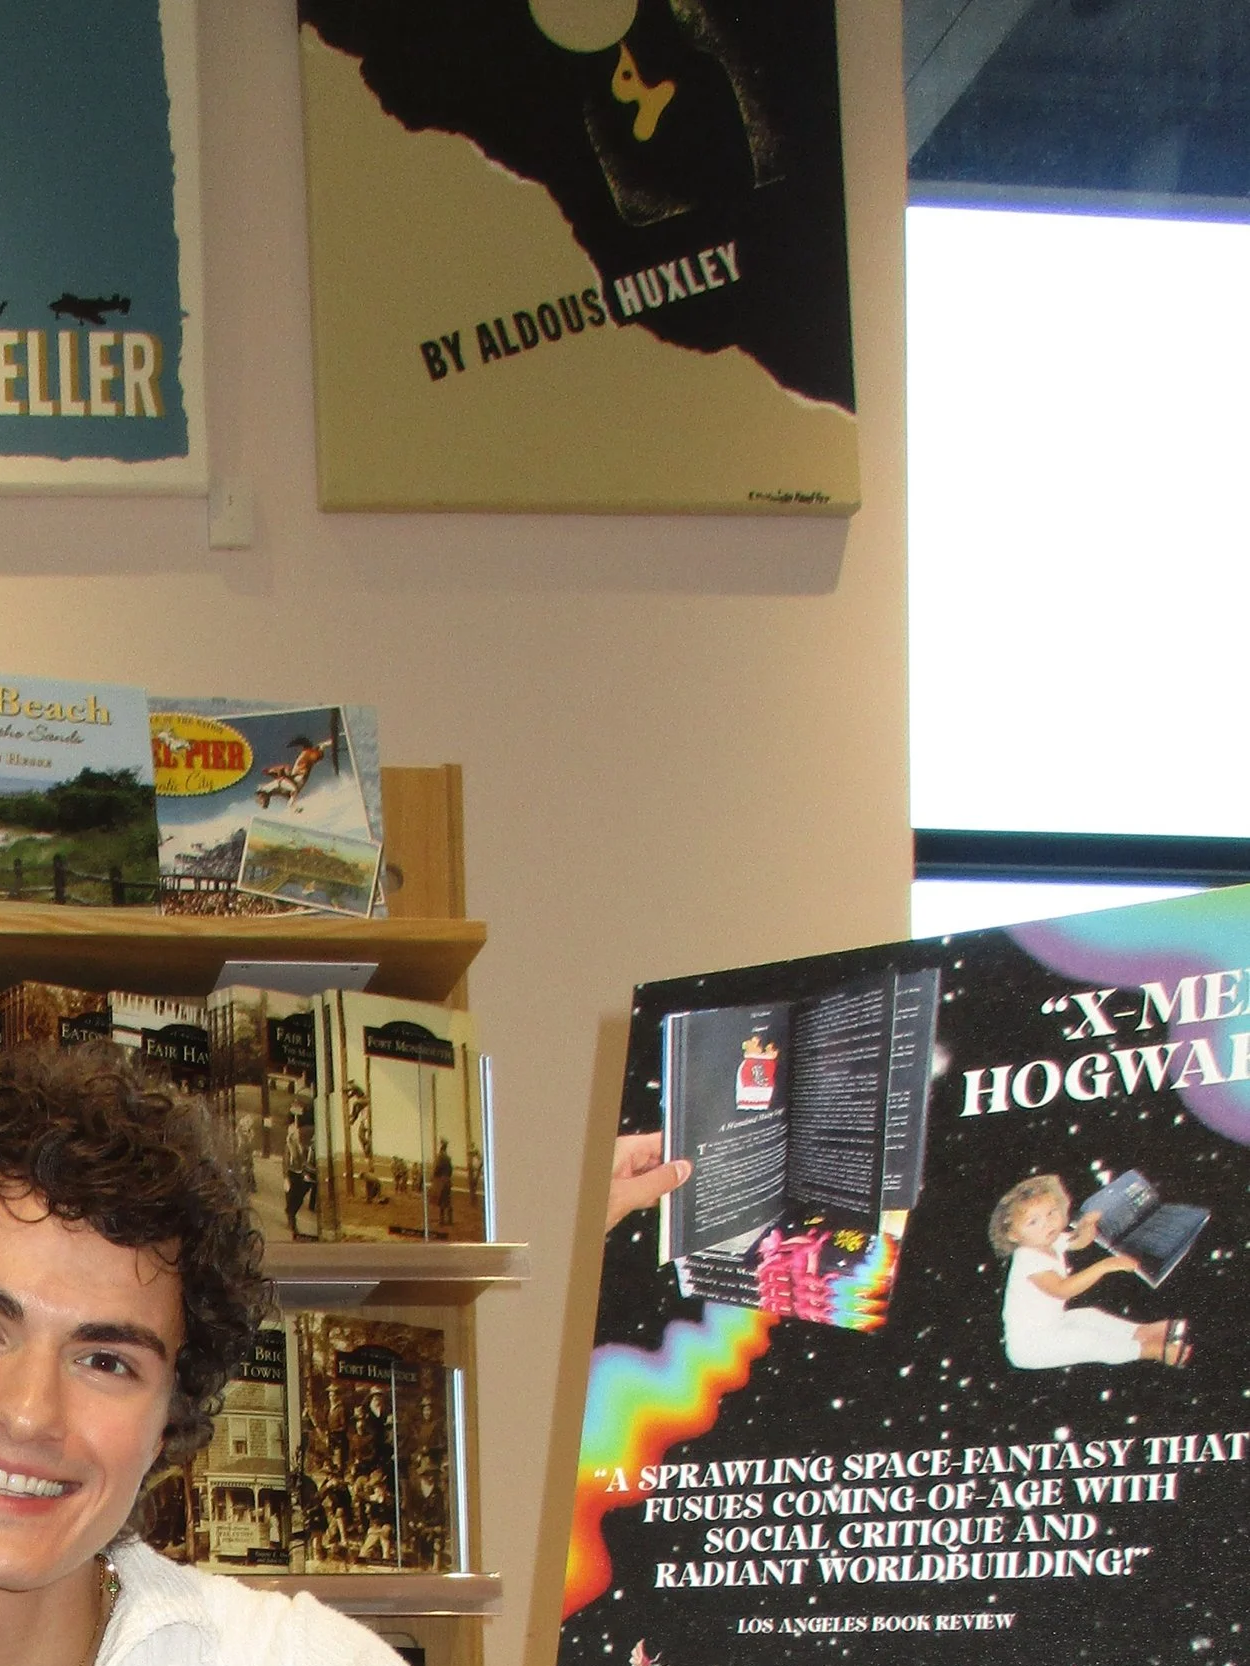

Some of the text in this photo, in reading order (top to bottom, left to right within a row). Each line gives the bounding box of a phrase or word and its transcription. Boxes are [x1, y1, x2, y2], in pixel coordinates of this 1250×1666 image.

[419, 241, 742, 383] BY ALDOUS HUXLEY
[185, 738, 246, 771] PIER
[146, 1038, 177, 1060] FAIR
[638, 1456, 835, 1492] SPRAWLING
[843, 1437, 1135, 1484] SPACE-FANTASY
[1143, 1431, 1250, 1466] THAT
[644, 1472, 1178, 1524] FUSUES COMING-OF-AGE WITH
[703, 1511, 1097, 1555] SOCIAL CRITIQUE AND
[653, 1557, 809, 1589] RADIANT
[737, 1611, 1016, 1634] LOS ANGELES BOOK REVIEW
